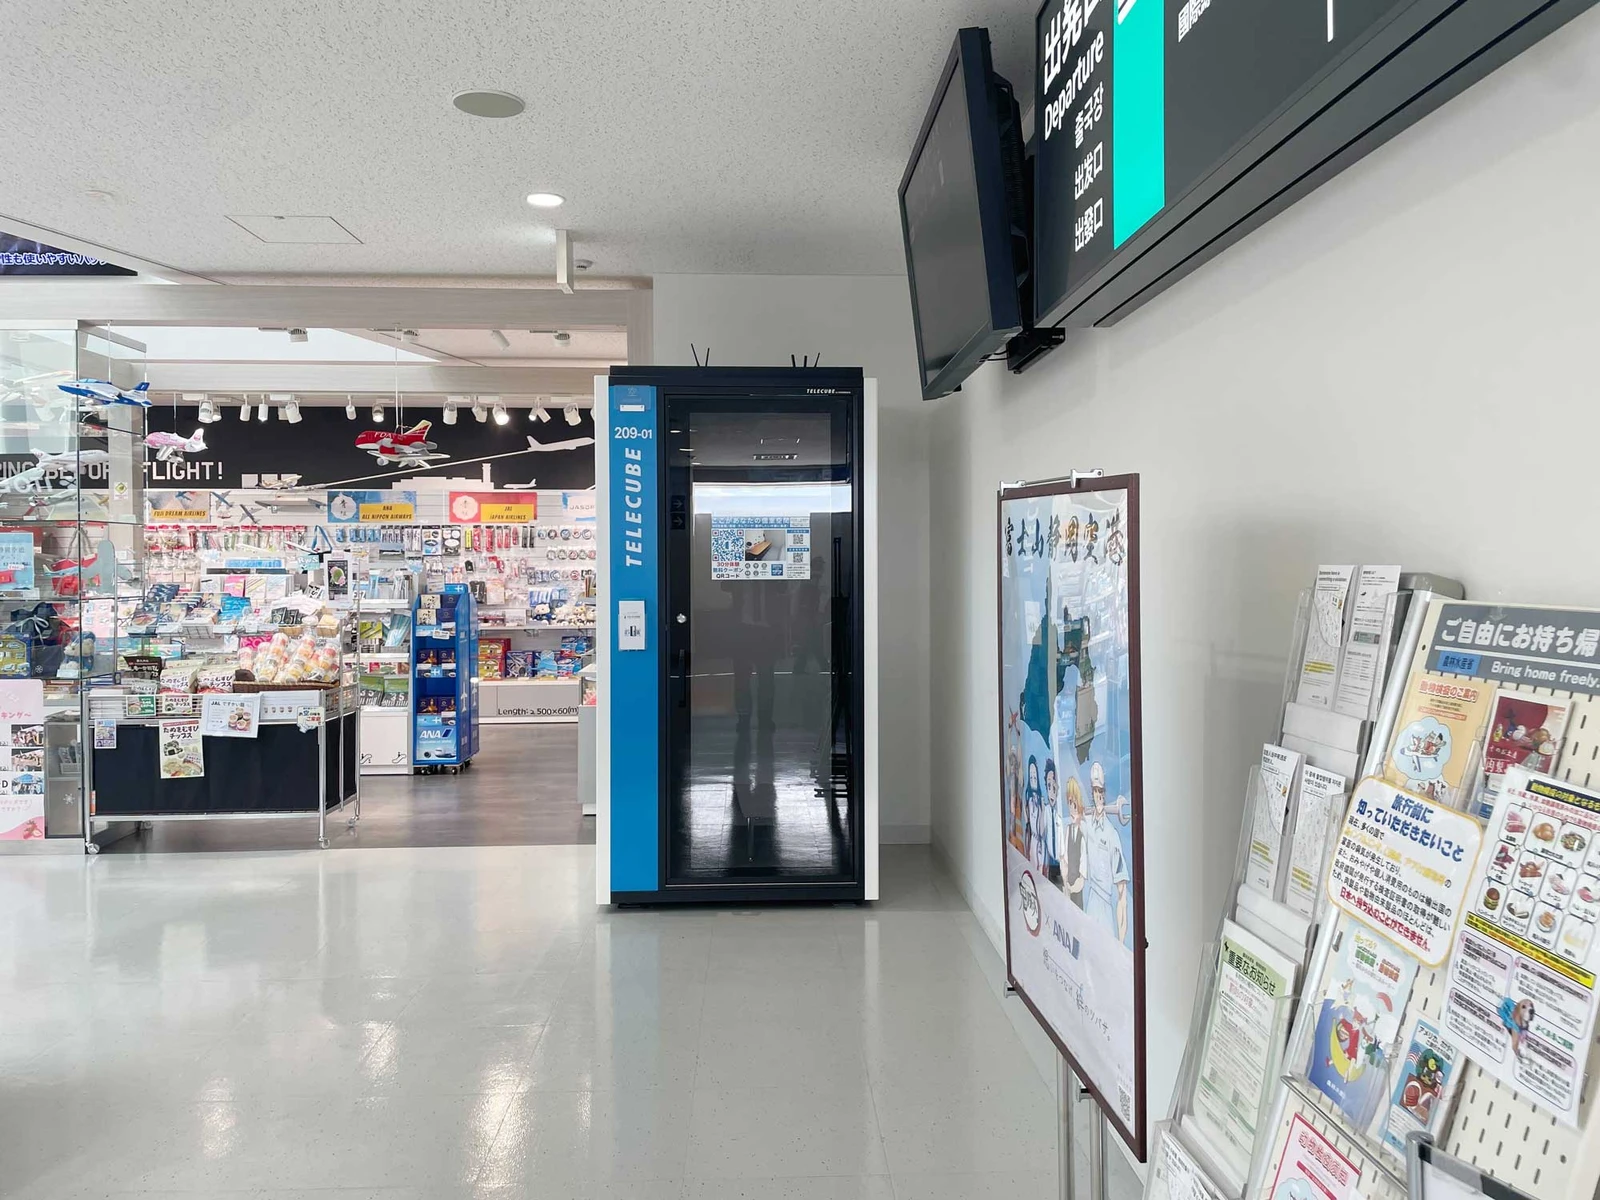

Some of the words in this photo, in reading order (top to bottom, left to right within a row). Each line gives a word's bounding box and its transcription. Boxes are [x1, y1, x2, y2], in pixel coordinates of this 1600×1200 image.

[1044, 31, 1104, 141] Departure
[1075, 82, 1104, 149] 출국장
[1075, 141, 1103, 200] 出发口
[1075, 198, 1103, 252] 出發口
[614, 426, 653, 440] 209-01
[625, 447, 643, 568] TELECUBE
[1491, 661, 1522, 678] Bring
[1523, 666, 1556, 681] home
[1559, 669, 1600, 688] freely.
[420, 730, 441, 739] ANA
[498, 708, 528, 716] Length:
[1356, 798, 1465, 862] 知っていただきたいこと
[1390, 793, 1434, 824] 旅行前に
[1053, 919, 1072, 955] ANA
[1227, 949, 1278, 998] 重要なお知らせ
